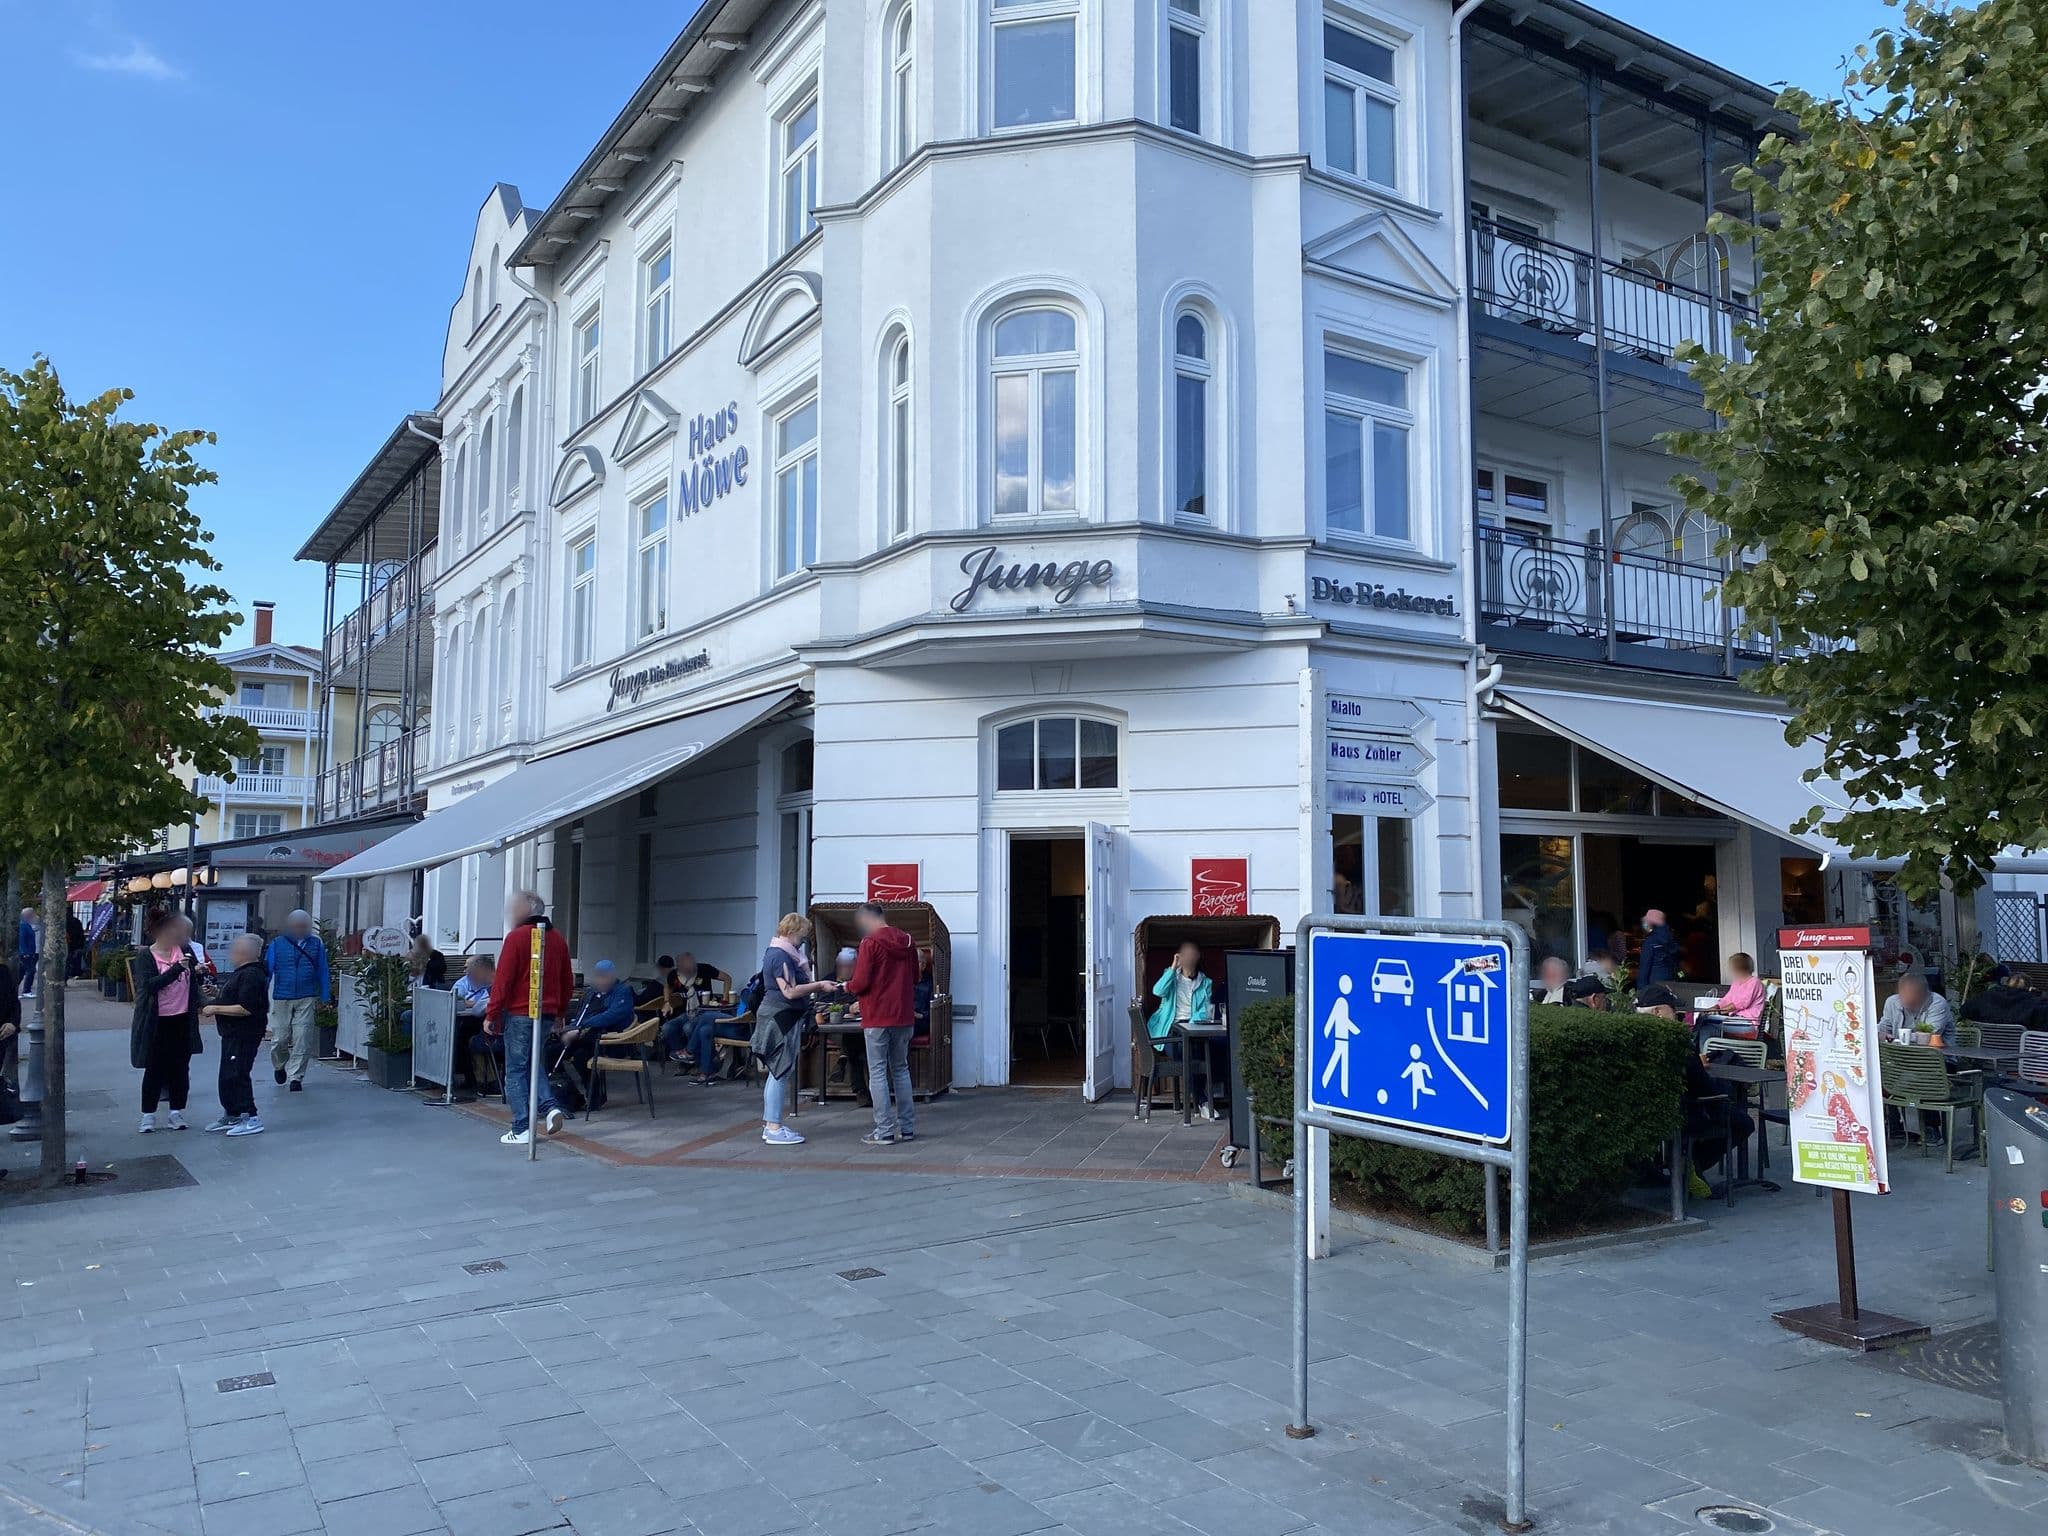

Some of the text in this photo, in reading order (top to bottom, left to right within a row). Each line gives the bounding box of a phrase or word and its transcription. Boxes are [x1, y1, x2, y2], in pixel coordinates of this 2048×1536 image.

[688, 400, 738, 460] Haus
[677, 445, 749, 521] Möwe
[949, 546, 1114, 612] Junge
[1311, 576, 1354, 604] Die
[606, 667, 648, 712] Junge
[1331, 700, 1361, 716] Rialto
[1331, 742, 1360, 759] Haus
[1373, 791, 1404, 805] HOTEL
[1794, 930, 1827, 947] Junge
[1783, 956, 1804, 969] DREI
[1784, 969, 1836, 985] GLÜCKLICH-
[1786, 988, 1823, 1001] MACHER
